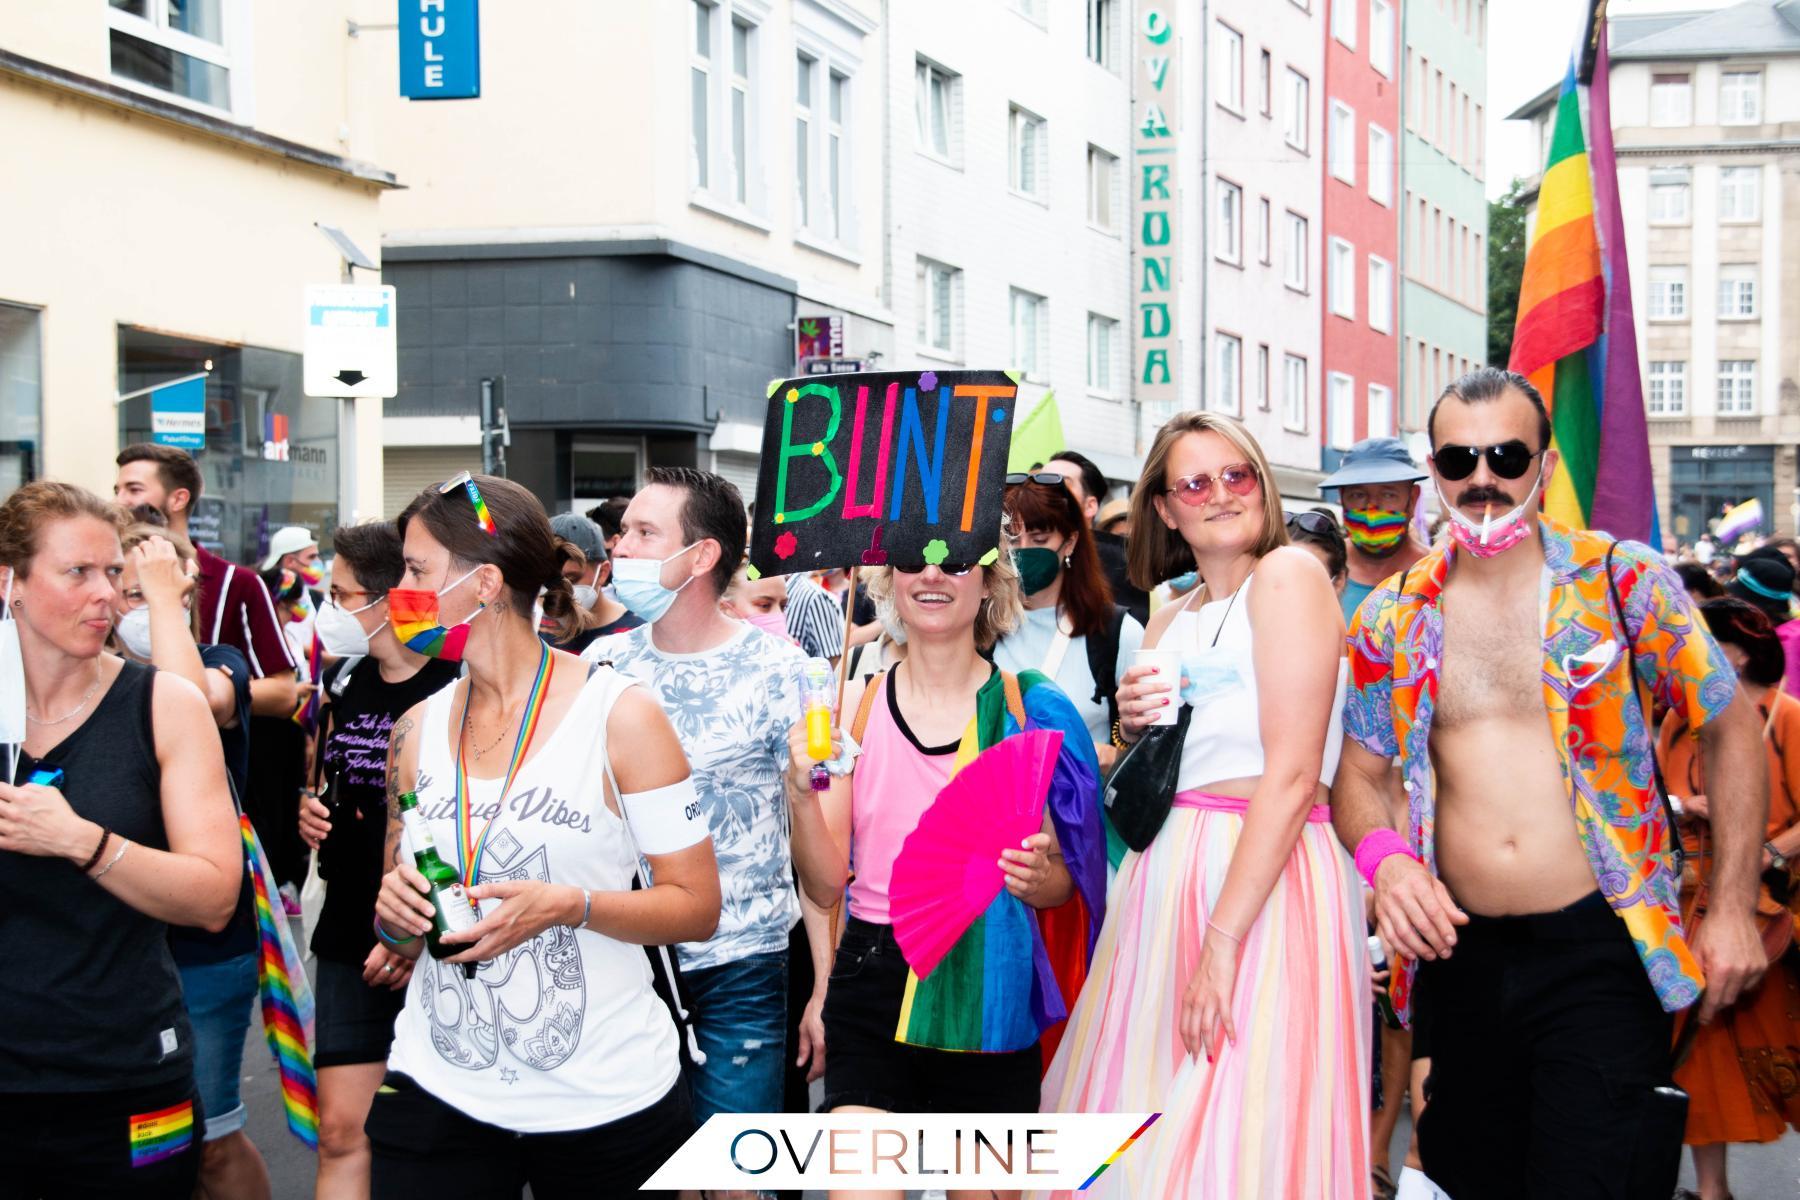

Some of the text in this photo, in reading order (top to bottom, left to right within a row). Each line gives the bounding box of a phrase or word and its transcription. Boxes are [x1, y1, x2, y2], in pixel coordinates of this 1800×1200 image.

[1140, 165, 1172, 384] RONDA
[773, 382, 1017, 532] BUNT
[510, 786, 592, 834] Vibes
